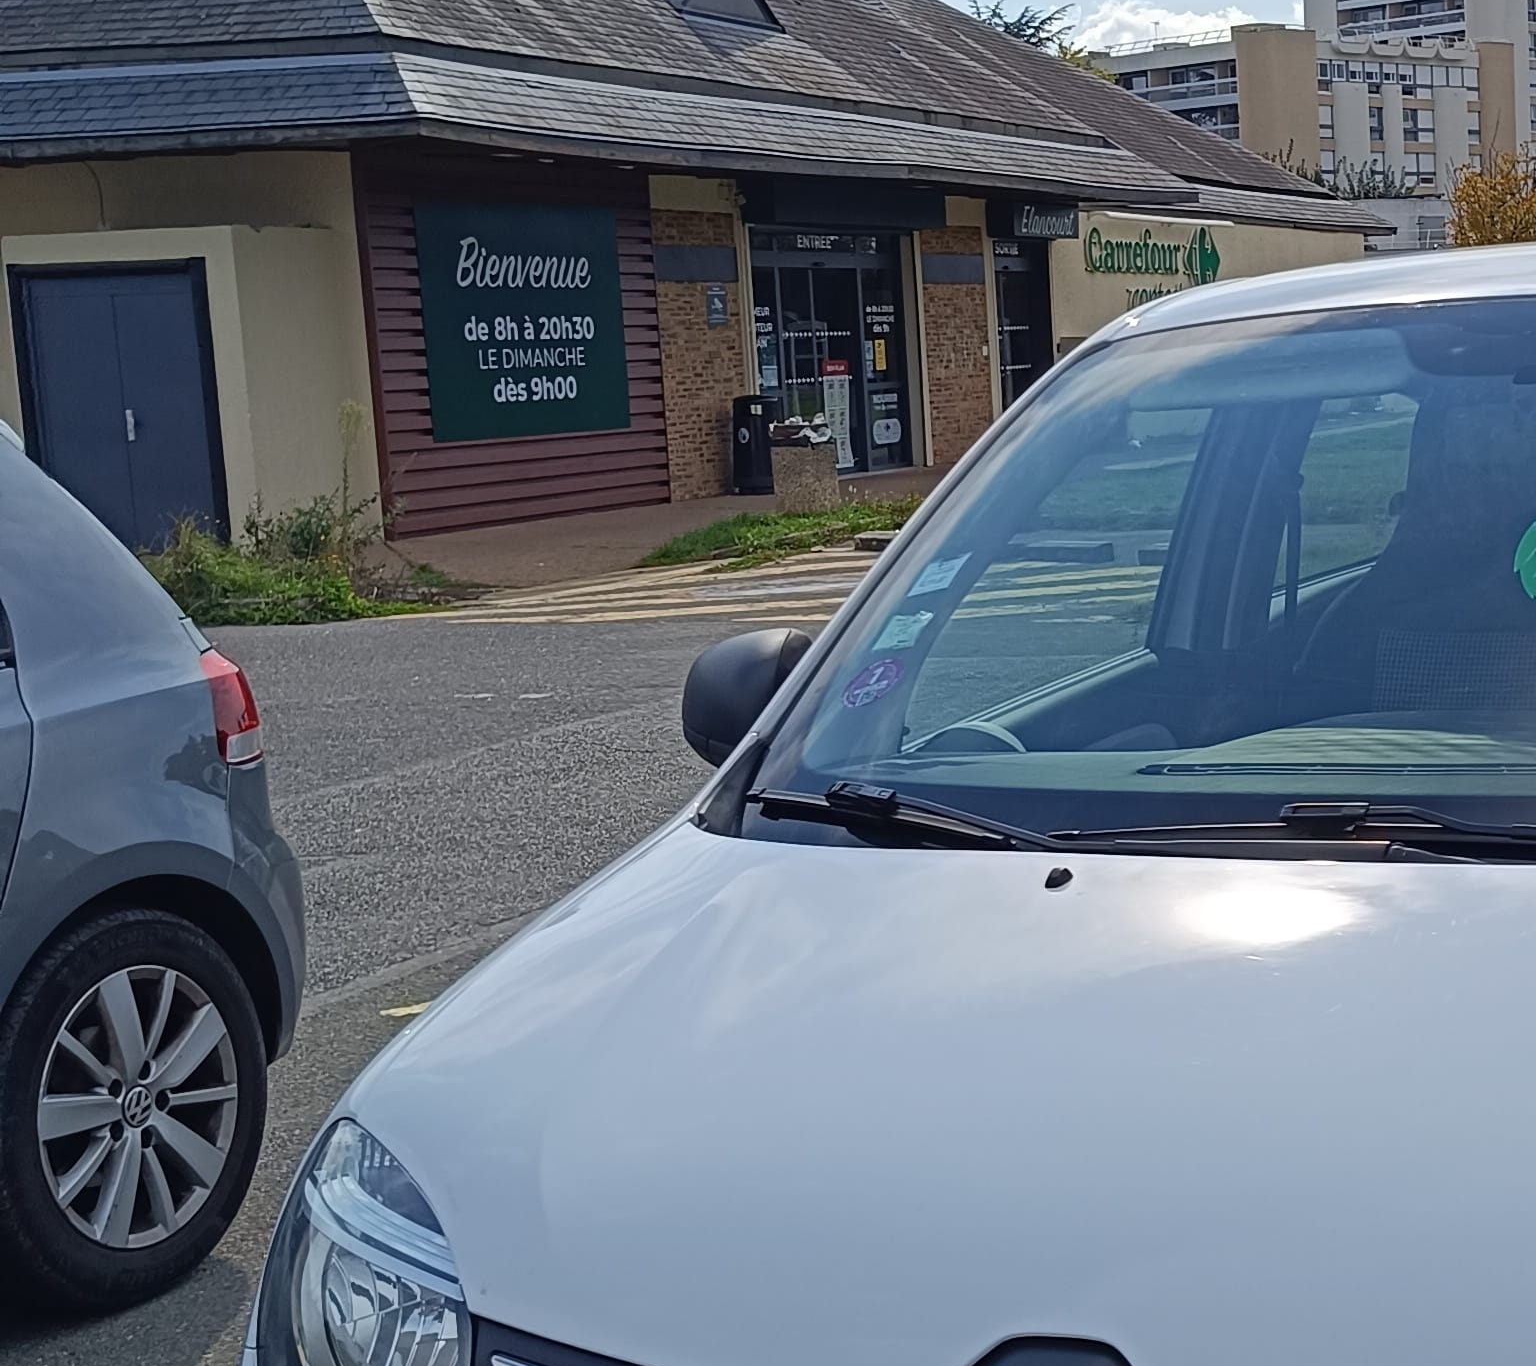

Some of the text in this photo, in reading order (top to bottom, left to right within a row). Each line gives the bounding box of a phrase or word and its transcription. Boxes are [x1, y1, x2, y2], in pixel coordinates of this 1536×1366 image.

[1021, 205, 1075, 236] Elancourt
[456, 236, 592, 289] Bienvenue
[1086, 227, 1181, 274] Carrefour
[464, 315, 595, 341] de 8h à 20h30
[478, 346, 586, 370] LE DIMANCHE
[493, 375, 578, 403] dès 9h00
